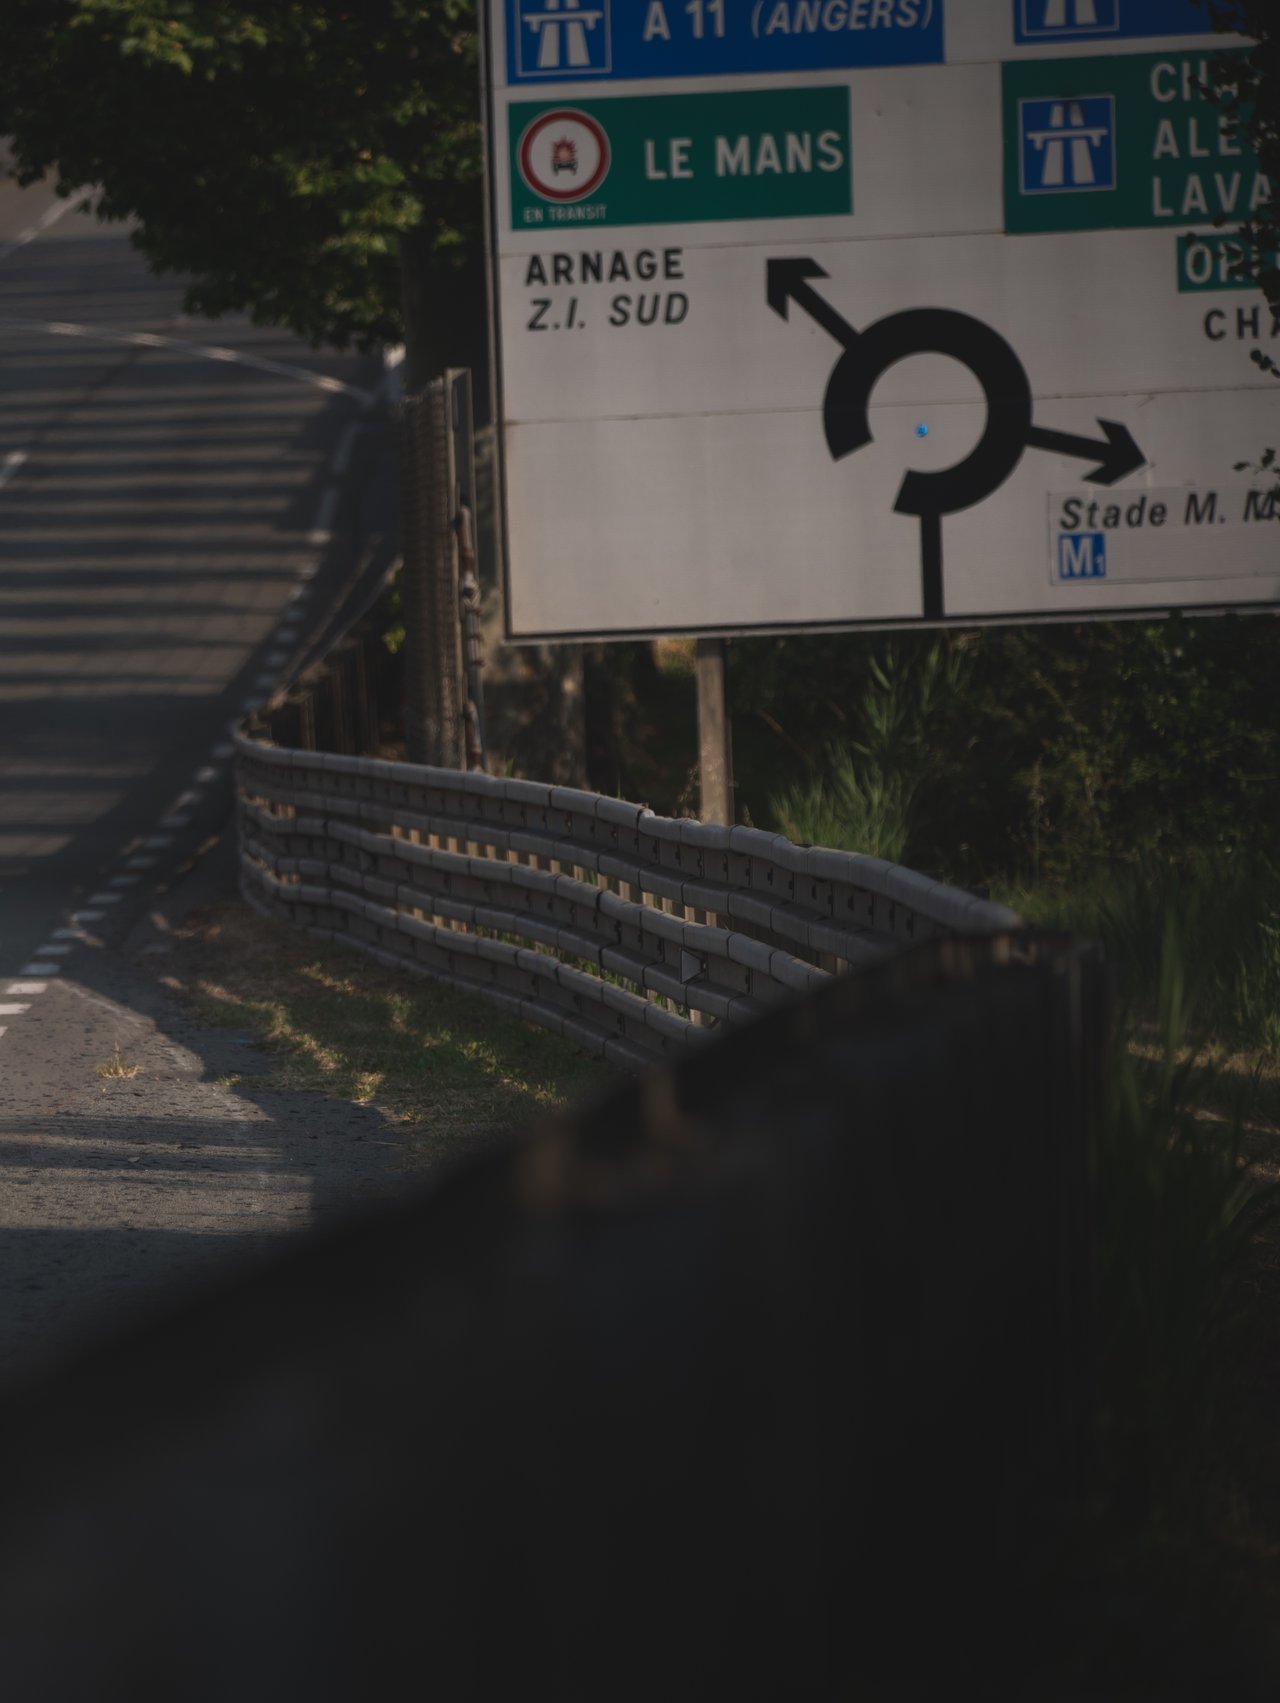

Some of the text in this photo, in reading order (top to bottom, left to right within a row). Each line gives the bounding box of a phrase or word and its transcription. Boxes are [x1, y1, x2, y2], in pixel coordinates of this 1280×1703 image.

[644, 0, 933, 42] A 11 (ANGERS)
[645, 130, 844, 180] LE MANS
[523, 204, 607, 223] EN TRANSIT
[525, 247, 685, 286] ARNAGE
[527, 292, 689, 331] Z.I. SUD
[1059, 495, 1168, 531] Stade
[1184, 491, 1226, 526] M.
